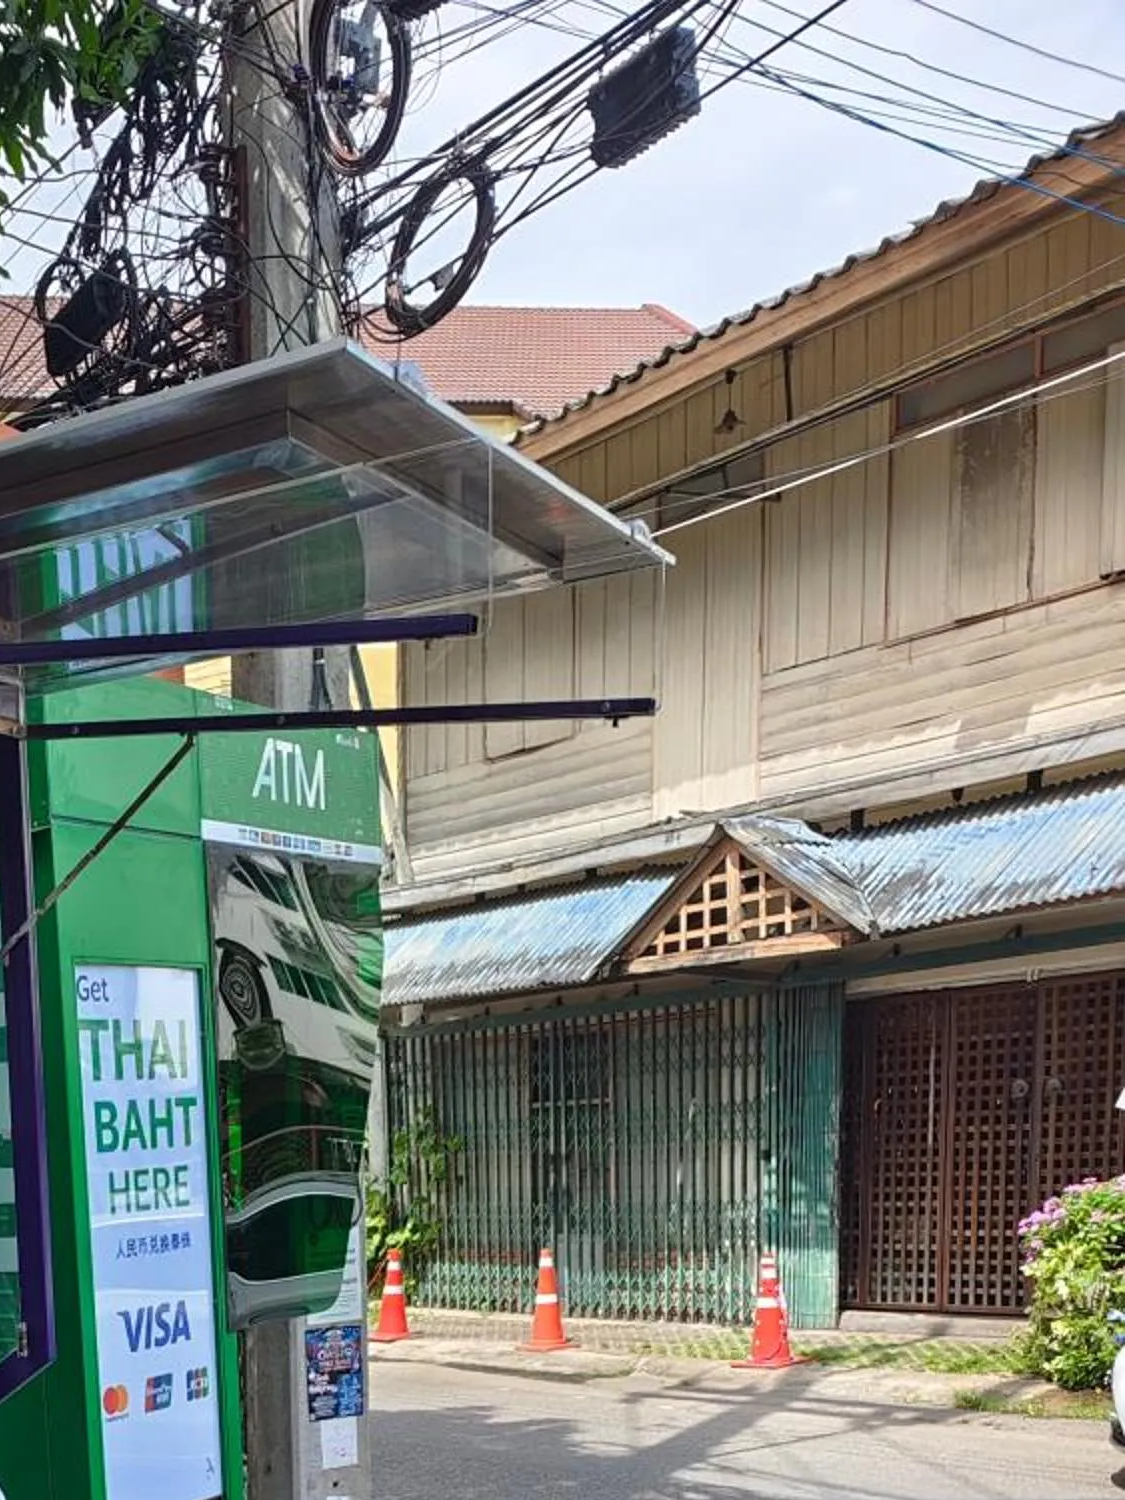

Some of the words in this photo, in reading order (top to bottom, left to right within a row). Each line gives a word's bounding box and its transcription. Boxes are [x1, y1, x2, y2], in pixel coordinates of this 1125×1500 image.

[251, 737, 326, 811] ATM
[76, 975, 109, 1002] Get
[77, 1019, 188, 1081] THAI
[94, 1097, 197, 1152] BAHT
[109, 1164, 191, 1214] HERE
[117, 1300, 191, 1352] VISA
